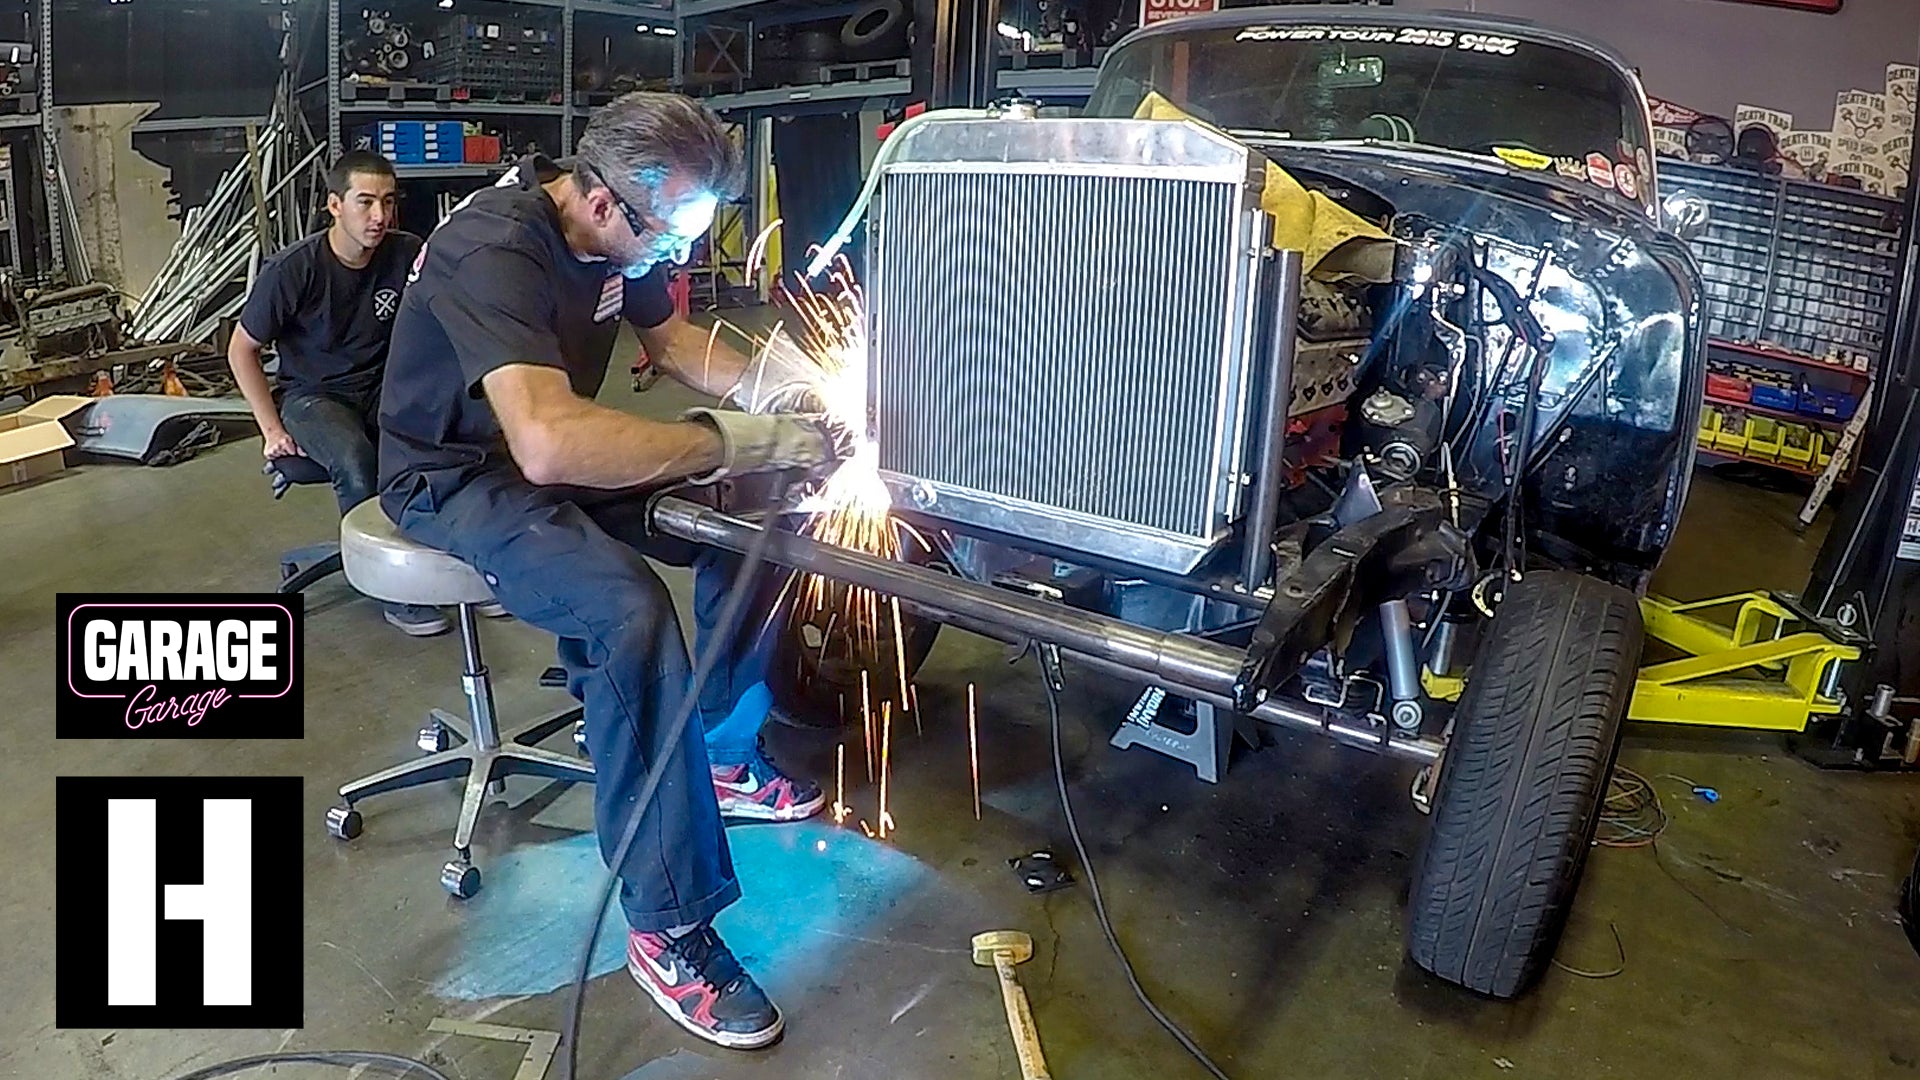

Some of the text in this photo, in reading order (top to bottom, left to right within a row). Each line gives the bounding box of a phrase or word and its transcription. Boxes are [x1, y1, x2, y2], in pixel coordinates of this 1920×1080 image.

[1235, 30, 1324, 41] POWER
[1328, 31, 1396, 42] TOUR
[1395, 28, 1455, 47] 2015
[1888, 71, 1916, 82] DEATH
[1838, 94, 1868, 105] DEATH
[1737, 110, 1789, 130] DEATH TRAP
[1781, 133, 1809, 149] DEATH
[1882, 137, 1909, 155] DEATH
